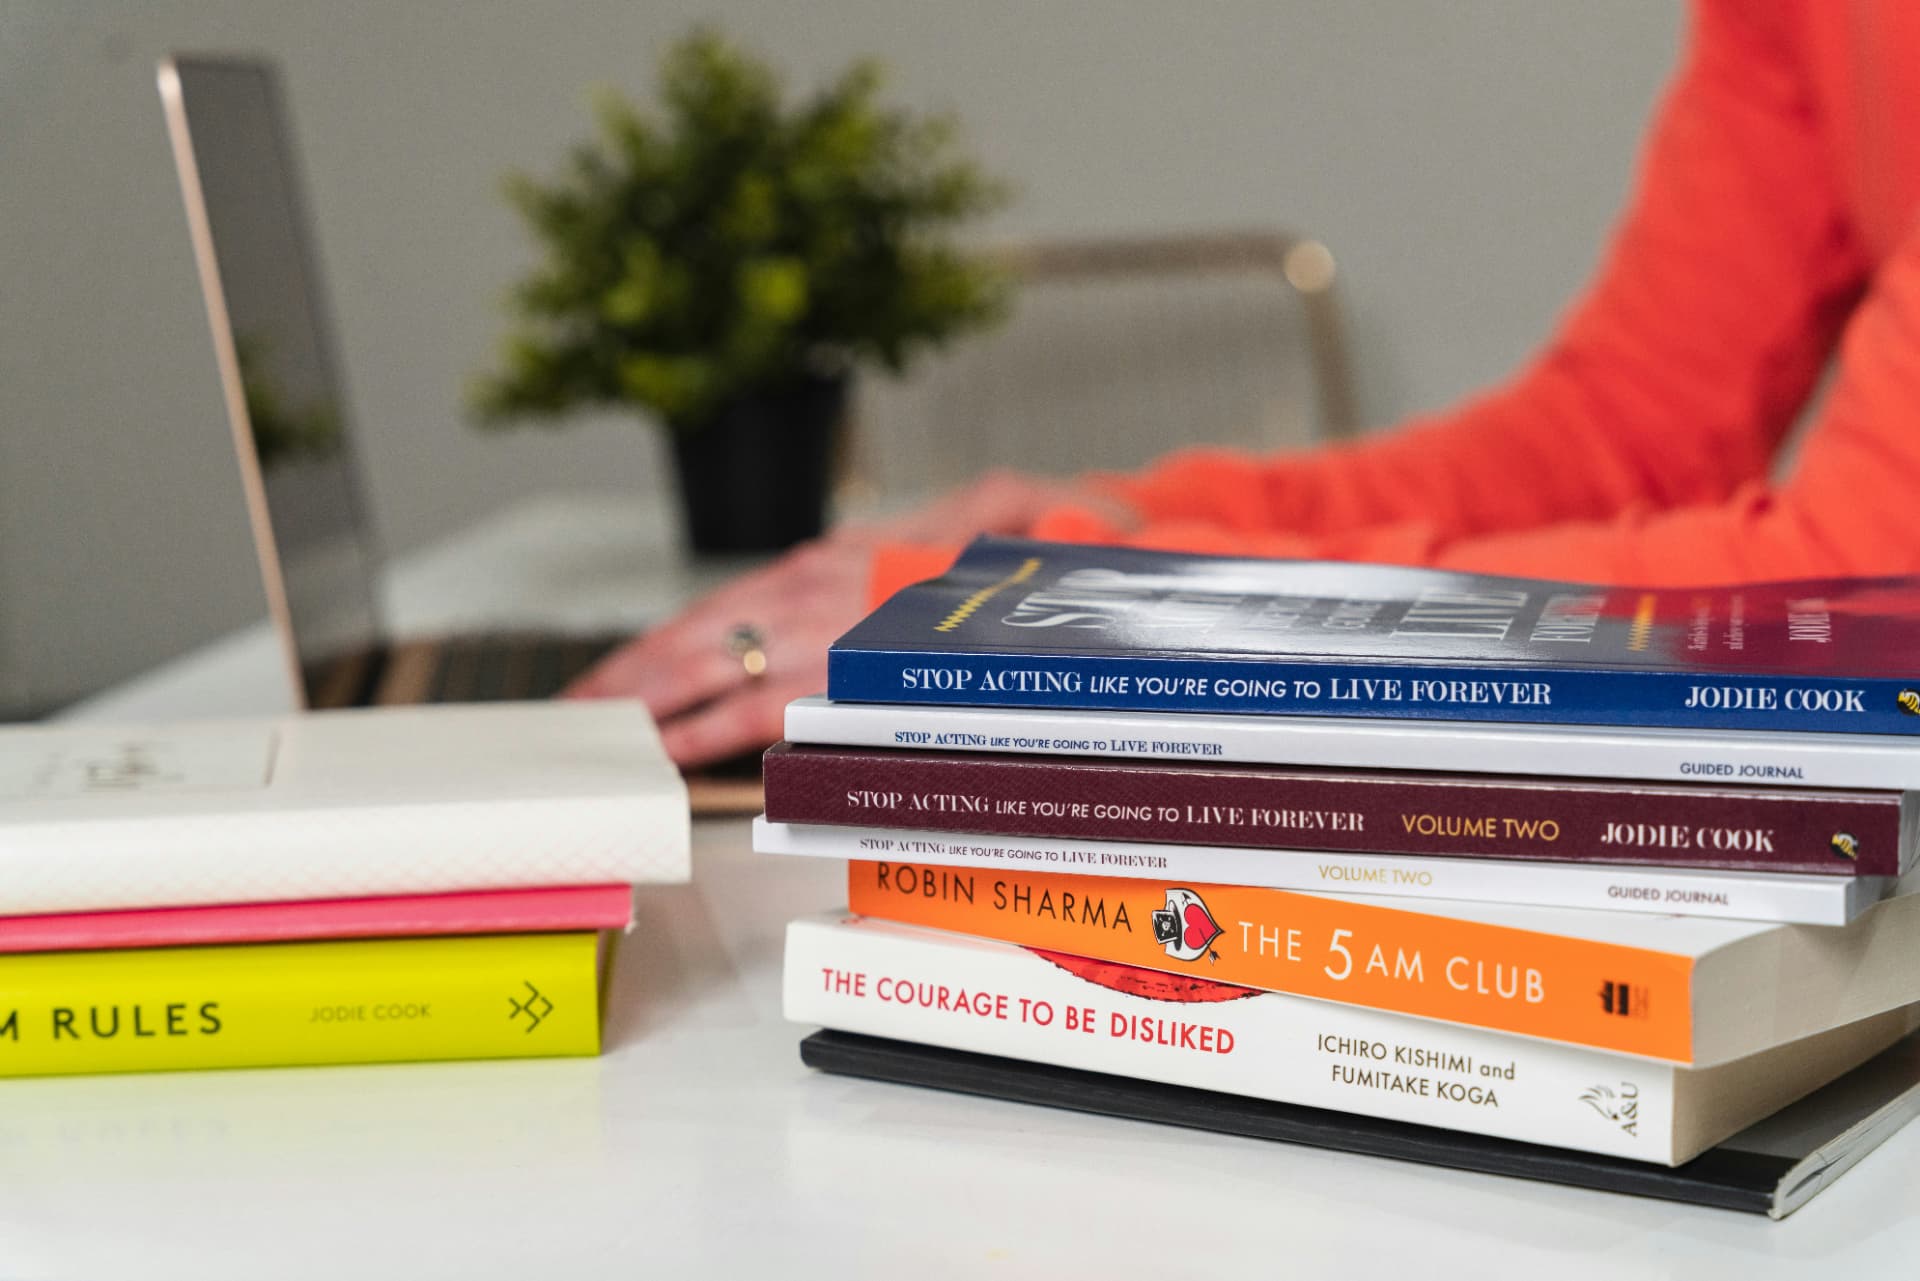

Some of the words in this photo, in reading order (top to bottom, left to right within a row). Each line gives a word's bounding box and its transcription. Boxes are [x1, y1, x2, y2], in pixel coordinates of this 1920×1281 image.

[903, 669, 972, 689] STOP
[979, 670, 1082, 692] ACTING
[1090, 676, 1129, 693] LIKE
[1136, 677, 1208, 695] YOU'RE
[1214, 679, 1286, 697] GOING
[1294, 681, 1320, 698] TO
[1331, 679, 1402, 700] LIVE
[1411, 680, 1551, 704] FOREVER
[1685, 687, 1777, 709] JODIE
[1785, 689, 1864, 712] COOK
[894, 731, 931, 744] STOP
[934, 733, 987, 747] ACTING
[989, 736, 1011, 748] LIKE
[1012, 737, 1051, 750] YOU'RE
[1052, 739, 1090, 751] GOING
[1093, 740, 1106, 751] TO
[1110, 739, 1148, 754] LIVE
[1151, 741, 1223, 756] FOREVER
[1679, 762, 1734, 776] GUIDED
[1737, 765, 1804, 780] JOURNAL
[848, 791, 902, 808] STOP
[910, 794, 988, 812] ACTING
[996, 801, 1026, 815] LIKE
[1032, 802, 1089, 818] YOU'RE
[1094, 805, 1152, 821] GOING
[1158, 808, 1179, 822] TO
[1188, 806, 1243, 825] LIVE
[1252, 809, 1363, 831] FOREVER
[1402, 815, 1496, 838] VOLUME
[1503, 819, 1559, 841] TWO
[1601, 823, 1689, 848] JODIE
[1697, 829, 1773, 852] COOK
[859, 838, 895, 851] STOP
[898, 840, 946, 854] ACTING
[948, 844, 968, 856] LIKE
[970, 848, 1004, 859] YOU'RE
[1007, 850, 1041, 860] GOING
[1045, 852, 1058, 861] TO
[1063, 851, 1096, 863] LIVE
[1101, 854, 1166, 868] FOREVER
[1318, 865, 1385, 882] VOLUME
[1392, 868, 1433, 886] TWO
[877, 861, 975, 905] ROBIN
[993, 881, 1133, 933] SHARMA
[1608, 886, 1660, 900] GUIDED
[1665, 890, 1728, 905] JOURNAL
[1239, 921, 1301, 961] THE
[1325, 929, 1352, 980] 5
[1366, 944, 1423, 982] AM
[1446, 957, 1544, 1003] CLUB
[53, 1002, 222, 1039] RULES
[310, 1004, 367, 1022] JODIE
[373, 1003, 432, 1021] COOK
[822, 968, 866, 997] THE
[877, 977, 1008, 1019] COURAGE
[1019, 999, 1053, 1026] TO
[1066, 1006, 1095, 1033] BE
[1111, 1012, 1234, 1054] DISLIKED
[1318, 1034, 1387, 1060] ICHIRO
[1395, 1046, 1472, 1073] KISHIMI
[1480, 1062, 1515, 1080] and
[1333, 1065, 1430, 1097] FUMITAKE
[1437, 1080, 1499, 1108] KOGA
[1619, 1083, 1639, 1136] A&U
